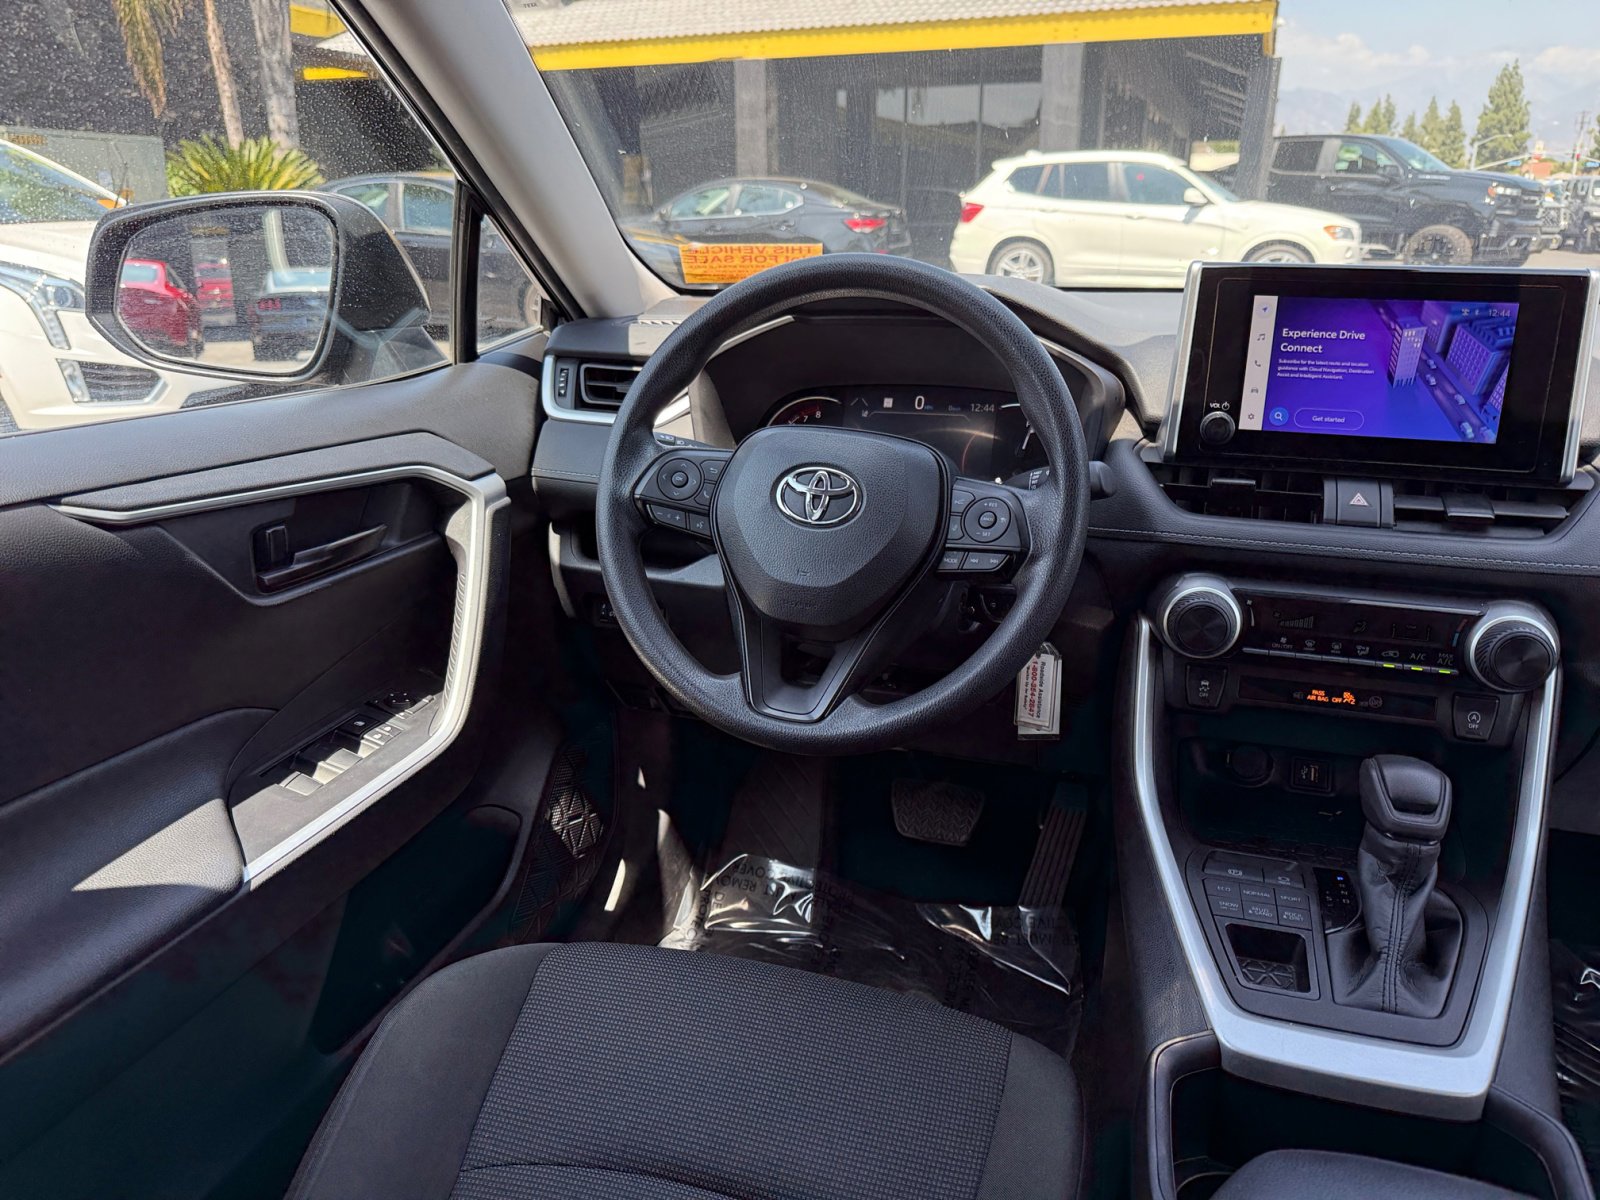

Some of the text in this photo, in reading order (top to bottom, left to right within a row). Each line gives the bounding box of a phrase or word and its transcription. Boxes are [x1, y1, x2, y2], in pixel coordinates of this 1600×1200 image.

[1489, 308, 1510, 317] 12:44
[1282, 328, 1365, 340] Experience Drive
[1280, 343, 1323, 353] Connect
[914, 395, 925, 410] 0
[970, 403, 995, 412] 12:44
[1409, 652, 1427, 660] A/C
[1437, 658, 1454, 666] A/C
[1038, 662, 1046, 687] Roadside
